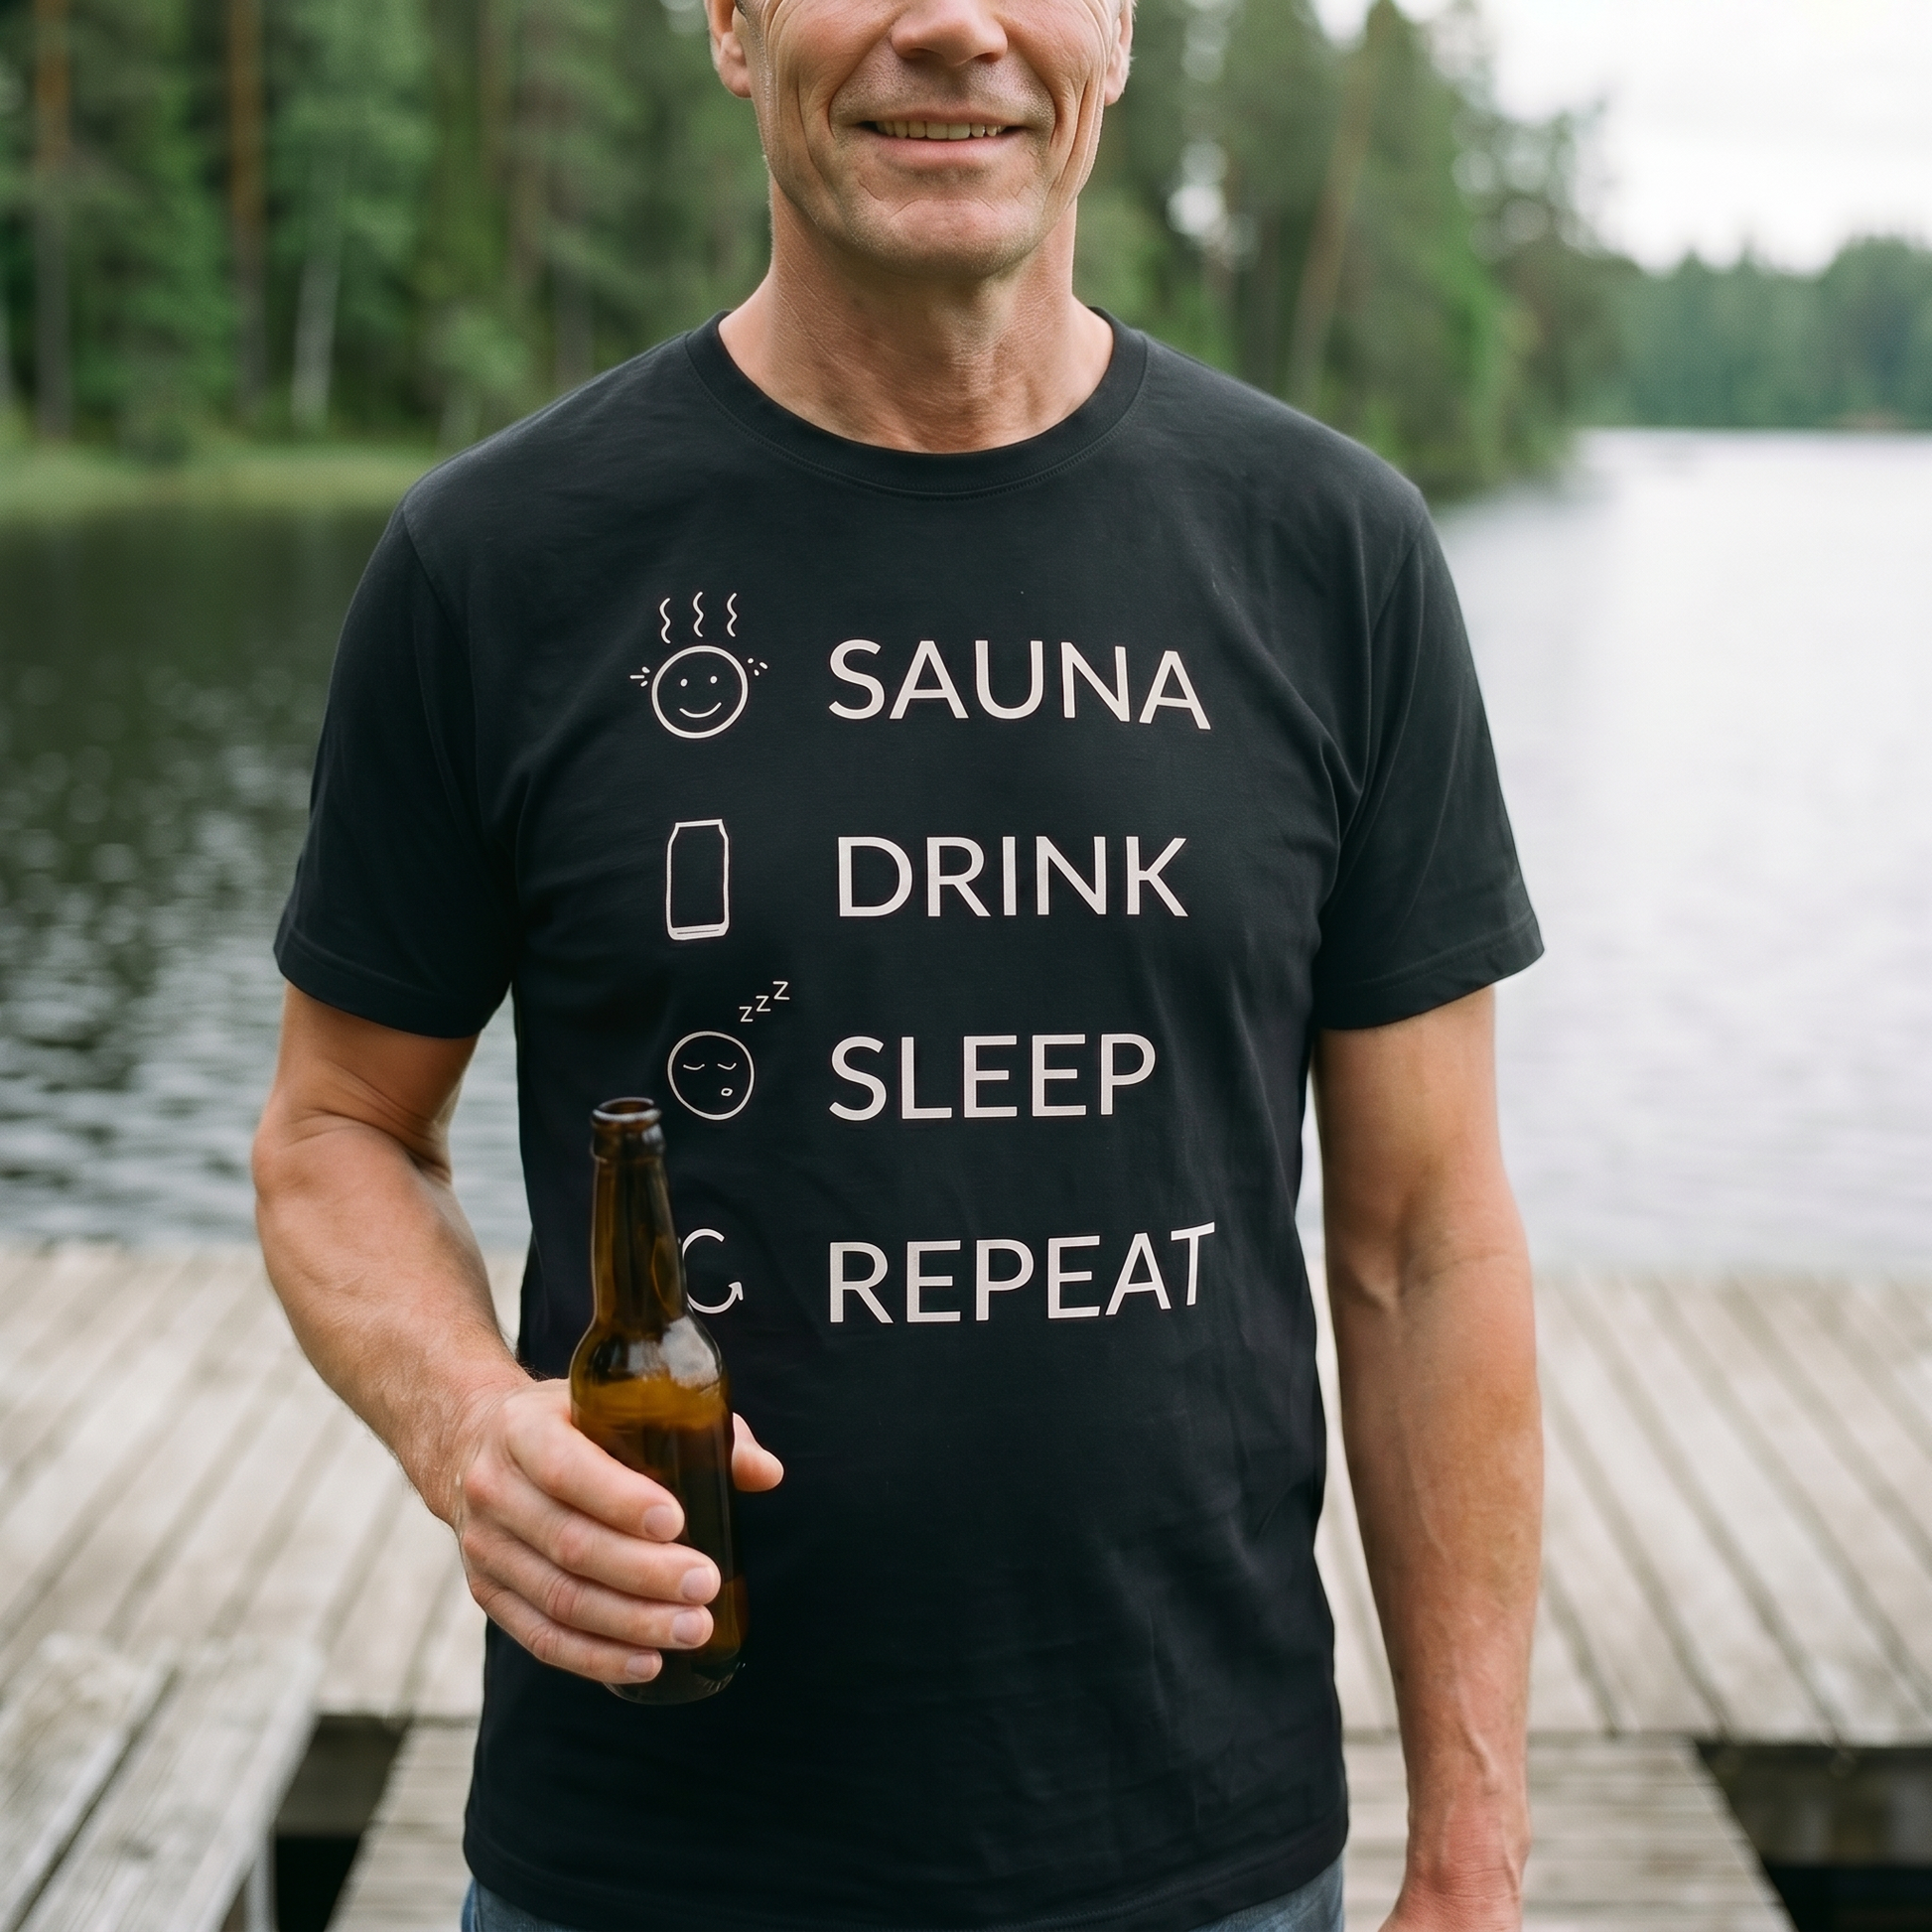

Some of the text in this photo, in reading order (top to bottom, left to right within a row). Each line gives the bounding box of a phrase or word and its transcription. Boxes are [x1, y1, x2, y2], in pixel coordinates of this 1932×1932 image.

[828, 638, 1212, 732] SAUNA
[836, 835, 1189, 918] DRINK
[828, 1033, 1157, 1122] SLEEP
[828, 1221, 1216, 1324] REPEAT
